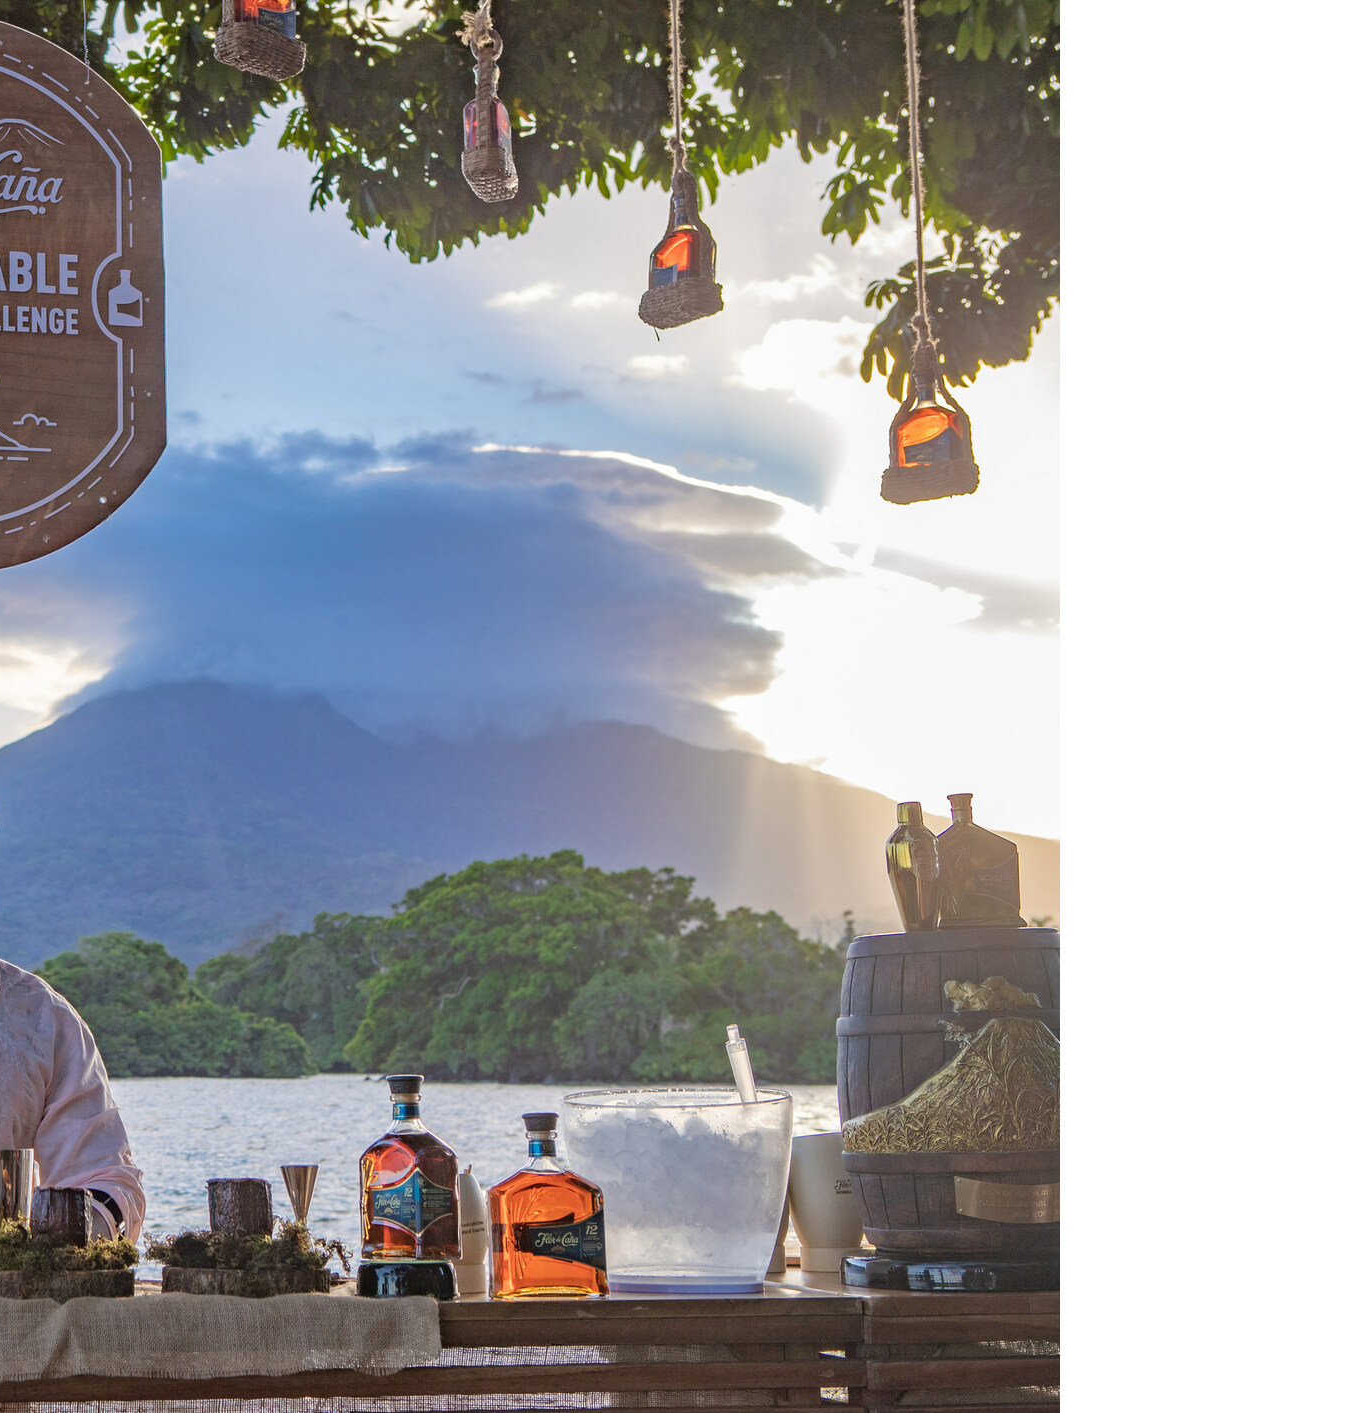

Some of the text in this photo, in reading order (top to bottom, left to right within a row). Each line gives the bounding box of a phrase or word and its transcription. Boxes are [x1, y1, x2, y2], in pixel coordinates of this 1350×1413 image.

[404, 1187, 413, 1197] 12
[586, 1225, 598, 1235] 12
[535, 1232, 556, 1248] Flor
[561, 1232, 579, 1247] Caña
